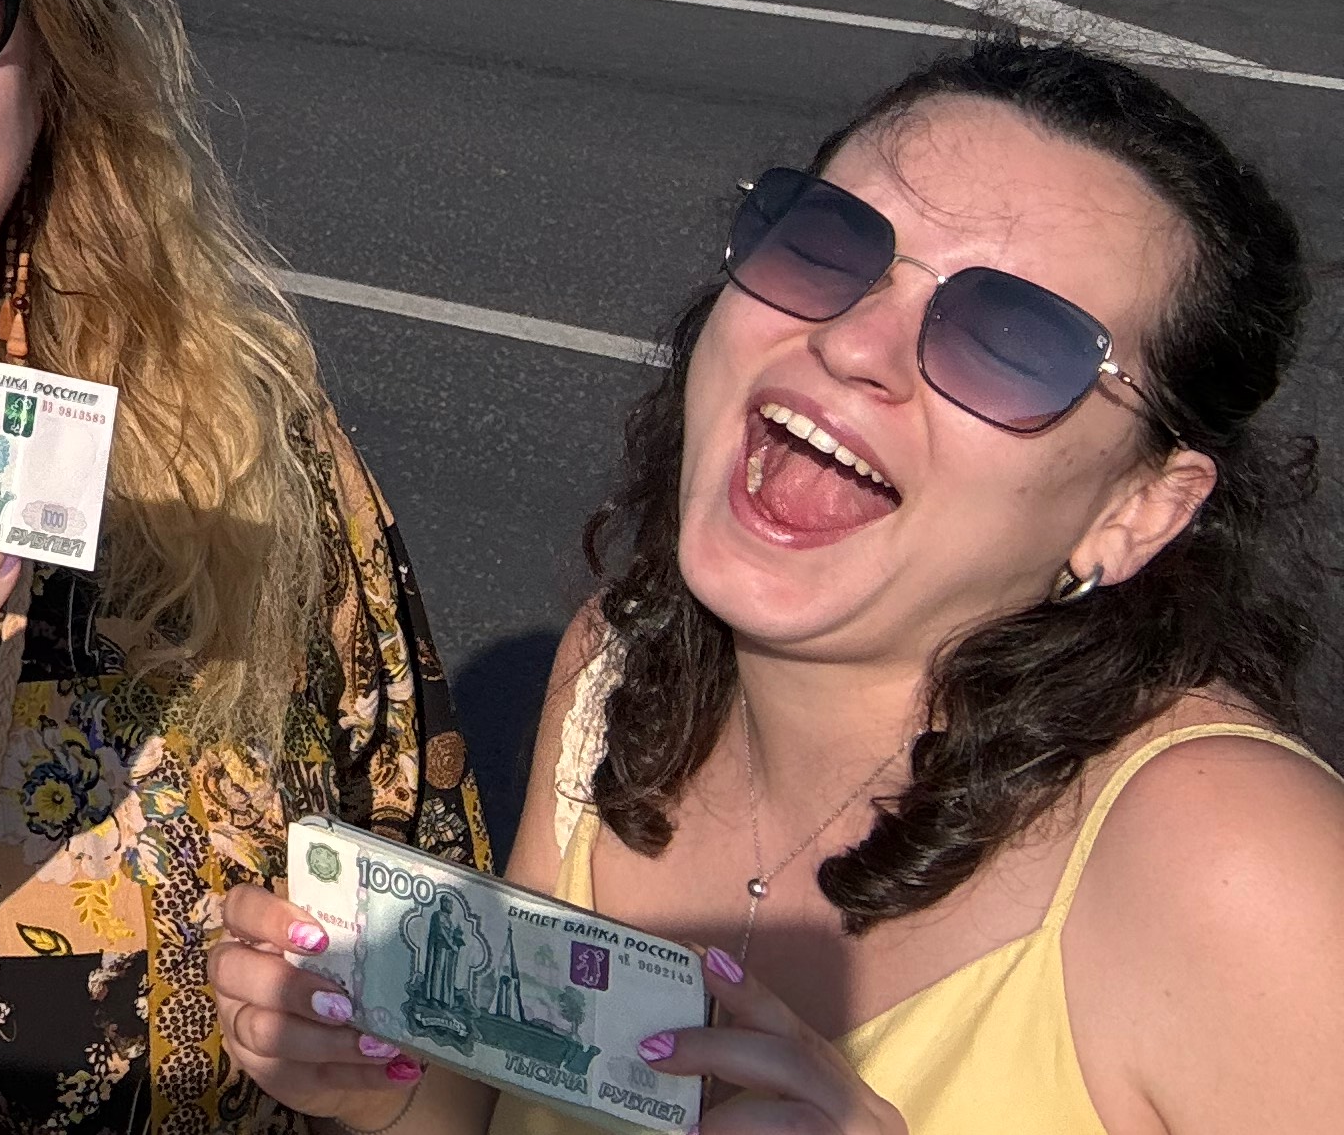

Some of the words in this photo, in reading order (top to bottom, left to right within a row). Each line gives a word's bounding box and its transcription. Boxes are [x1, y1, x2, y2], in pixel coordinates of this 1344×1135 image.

[33, 382, 88, 404] РОССИИ
[356, 856, 436, 907] 1000
[507, 905, 560, 929] БИЛЕТ
[563, 921, 619, 945] БАНКА
[624, 936, 690, 967] РОССИИ
[505, 1052, 588, 1095] ТЫСЯЧА
[598, 1081, 687, 1125] РУБЛЕЙ
